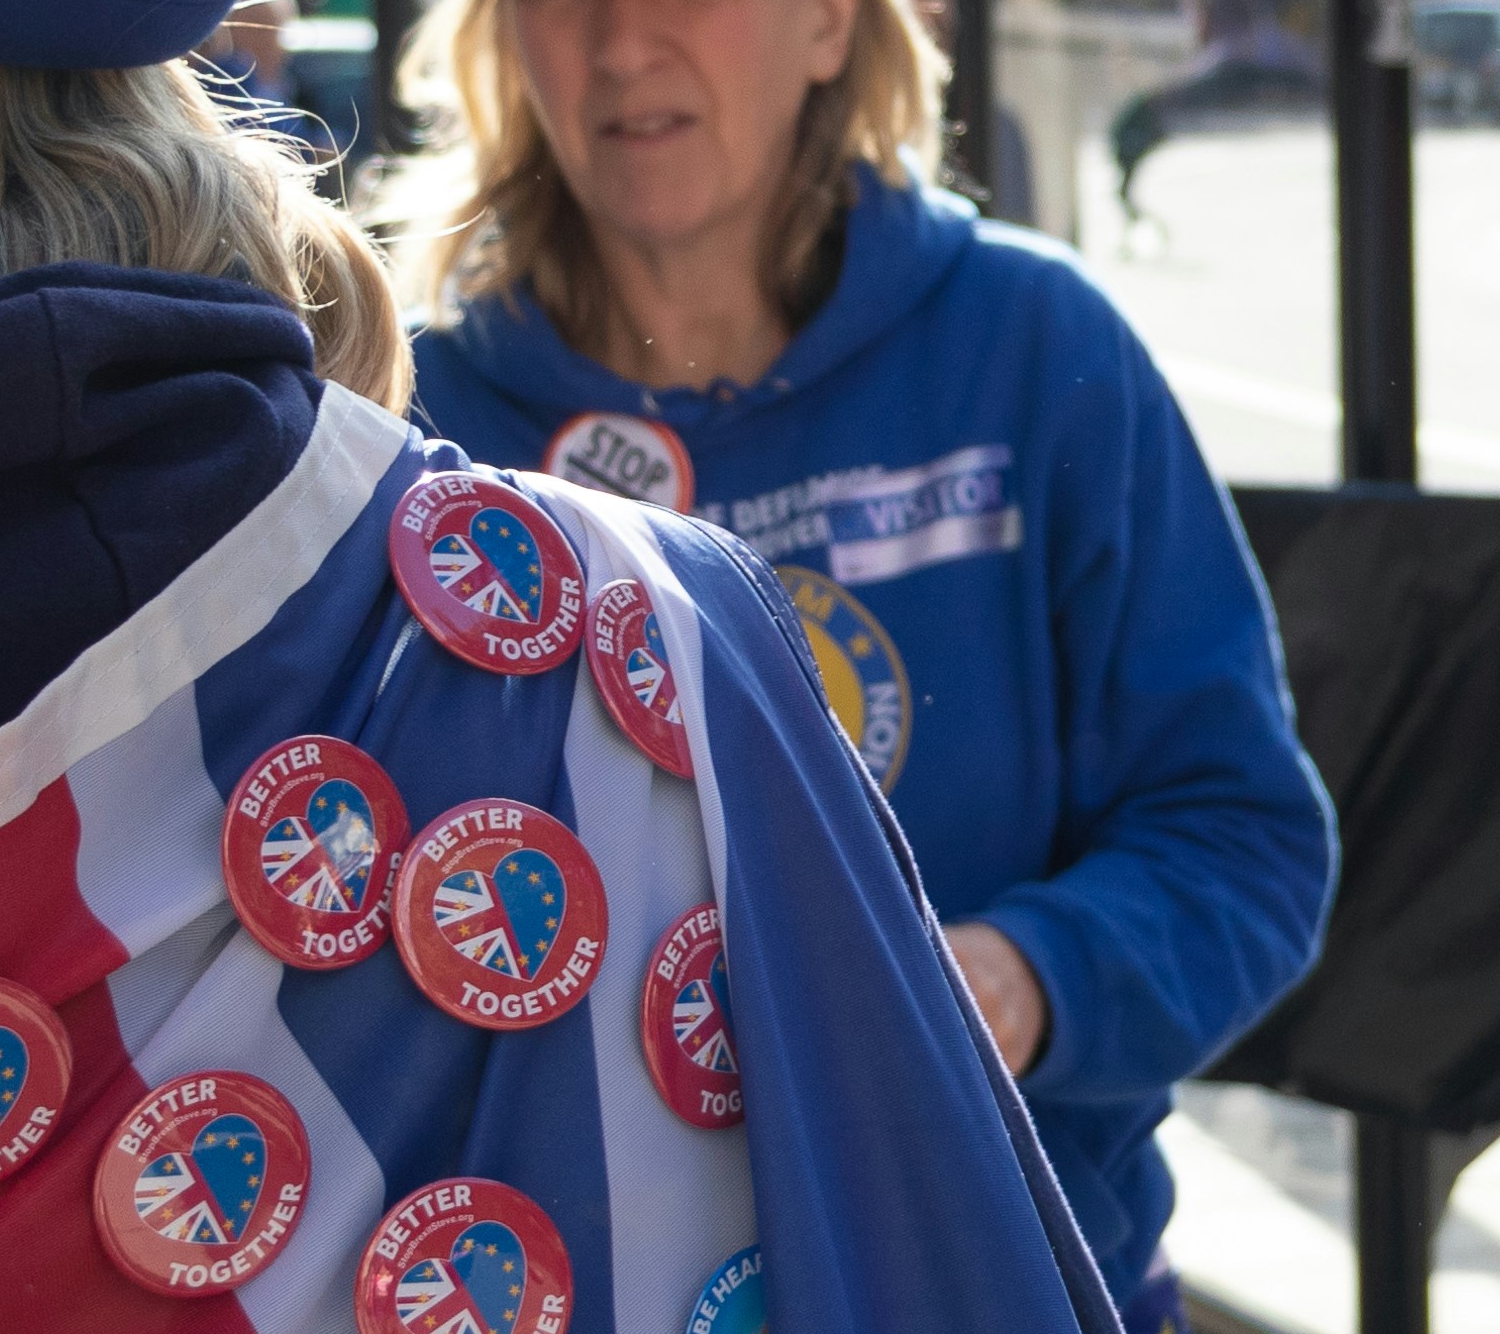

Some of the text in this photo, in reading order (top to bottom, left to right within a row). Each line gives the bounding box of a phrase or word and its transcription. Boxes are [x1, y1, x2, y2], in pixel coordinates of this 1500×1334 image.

[585, 425, 669, 491] STOP
[402, 476, 478, 533] BETTER
[864, 472, 1003, 536] VISITOR
[483, 576, 581, 660] TOGETHER
[596, 584, 639, 655] BETTER
[240, 743, 322, 819] BETTER
[422, 807, 523, 863] BETTER
[461, 936, 599, 1018] TOGETHER
[657, 908, 720, 981] BETTER
[117, 1078, 217, 1156] BETTER
[167, 1182, 303, 1288] TOGETHER
[376, 1184, 472, 1261] BETTER
[711, 1252, 762, 1304] HEA
